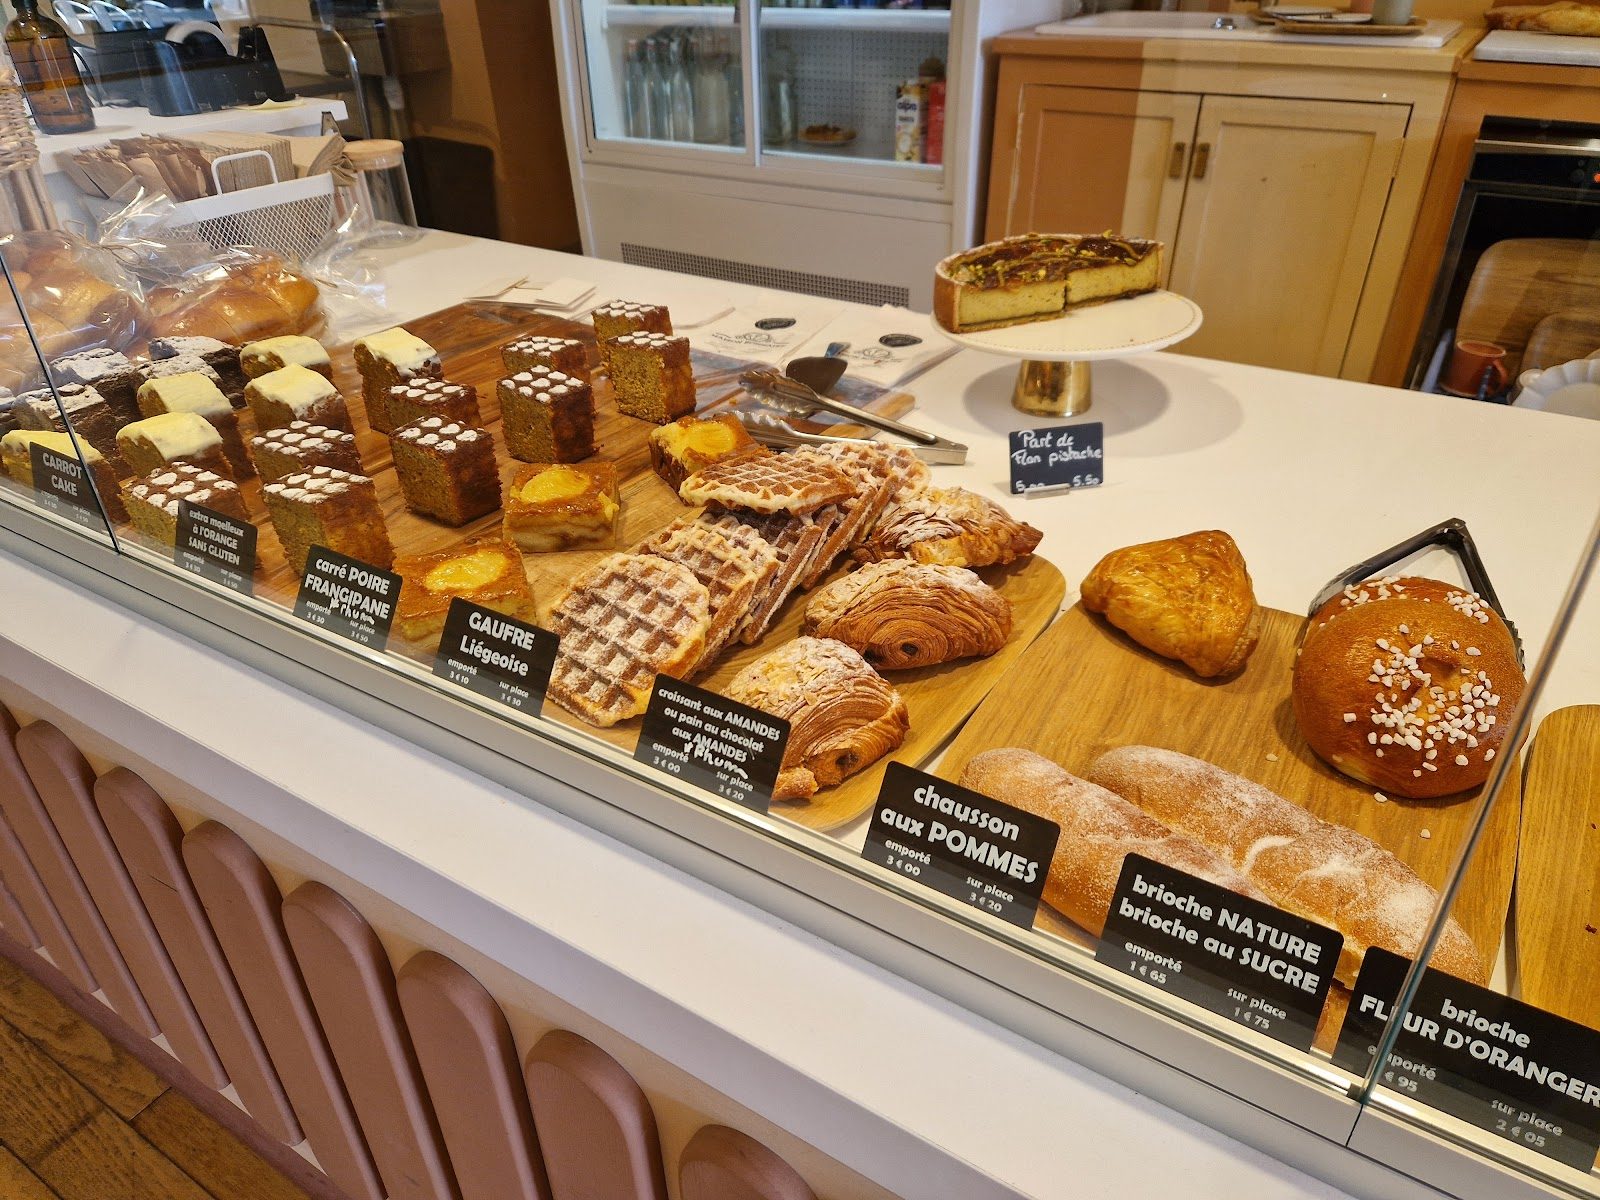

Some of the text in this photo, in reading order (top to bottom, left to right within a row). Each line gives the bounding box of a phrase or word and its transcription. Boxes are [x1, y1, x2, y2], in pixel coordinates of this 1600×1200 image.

[1018, 430, 1074, 448] Part de
[42, 452, 82, 480] CARROT
[1011, 445, 1102, 467] Flan pistache
[51, 474, 78, 497] CAKE
[189, 509, 209, 524] extra
[192, 523, 238, 550] à l'ORANGE
[188, 536, 240, 566] SANS GLUTEN
[315, 558, 390, 595] carré POIRE
[304, 573, 391, 620] FRANGIPANE
[306, 611, 312, 619] 3
[349, 620, 375, 635] sur place
[468, 611, 535, 651] GAUFRE
[447, 658, 478, 676] emporté
[460, 634, 529, 677] Liégeoise
[449, 670, 470, 685] 3 € 10
[499, 681, 529, 698] sur place
[501, 693, 521, 707] 3 € 30
[658, 688, 781, 741] croissant aux AMANDES
[664, 706, 765, 753] ou pain au chocolat
[652, 742, 689, 763] emporté
[672, 726, 693, 741] aux
[693, 731, 748, 763] AMANDES
[653, 755, 681, 774] 3 € 00
[716, 770, 754, 792] sur place
[718, 784, 745, 801] 3 € 20
[913, 784, 1020, 841] chausson
[880, 807, 1039, 884] aux POMMES
[885, 839, 932, 865] emporté
[886, 854, 921, 877] 3 € 00
[966, 875, 1014, 903] sur place
[969, 891, 1003, 913] 3 € 20
[1132, 873, 1322, 966] brioche NATURE
[1119, 896, 1320, 995] brioche au SUCRE
[1124, 940, 1183, 974] emporté
[1129, 960, 1167, 984] 1 € 65
[1227, 987, 1288, 1021] sur place
[1234, 1006, 1271, 1030] 1 € 75
[1440, 998, 1531, 1049] brioche
[1359, 994, 1600, 1108] FLUR D'ORANGER
[1367, 1044, 1437, 1081] eporté
[1384, 1071, 1418, 1092] € 95
[1491, 1099, 1564, 1137] sur place
[1496, 1118, 1546, 1148] 2 € 05
